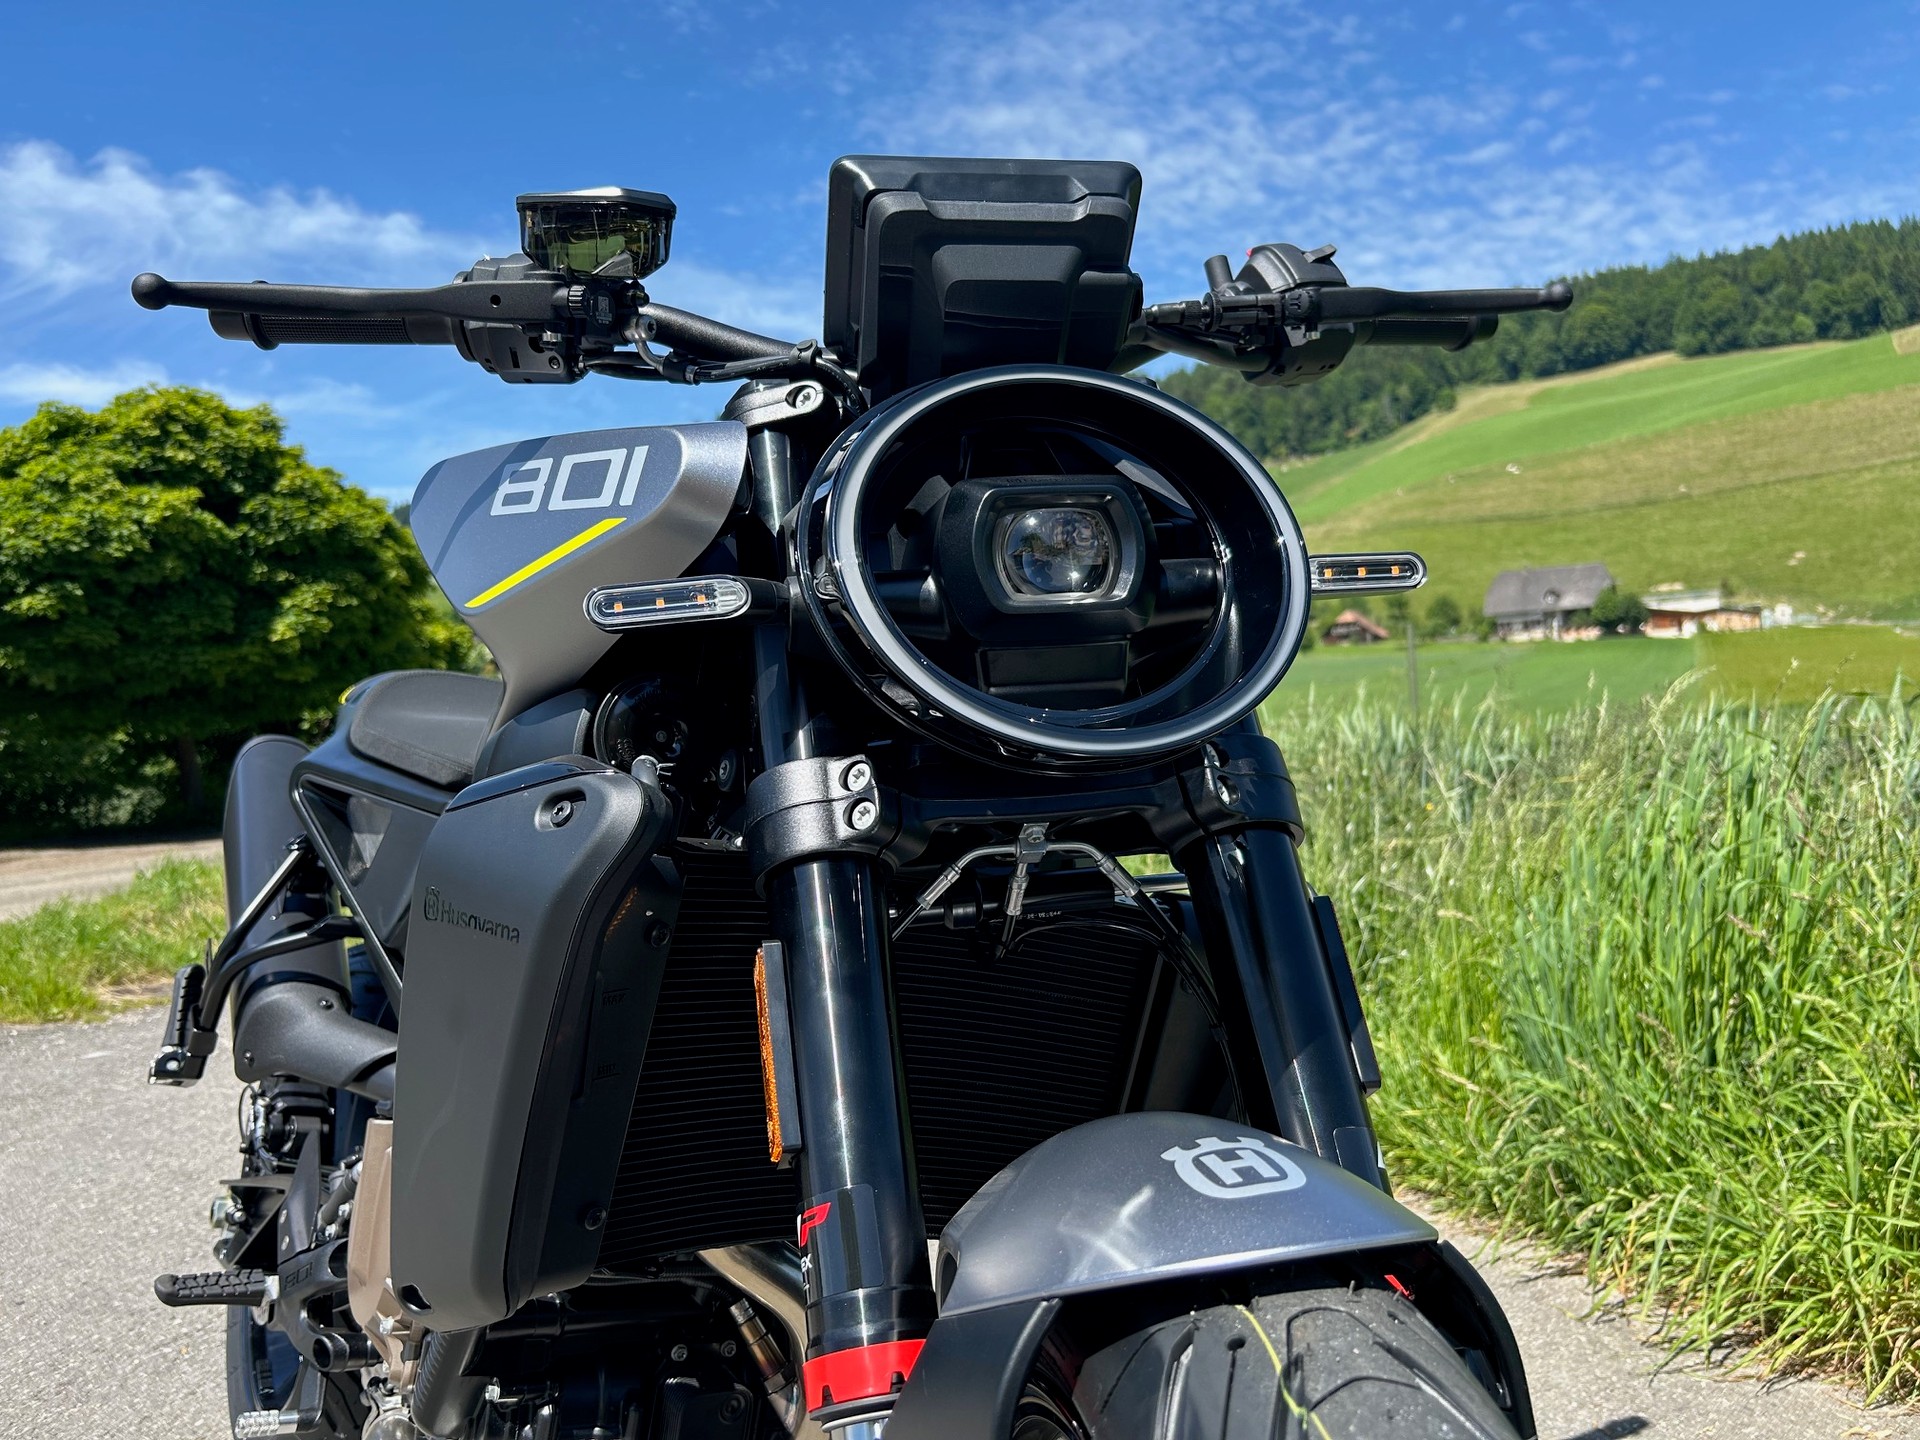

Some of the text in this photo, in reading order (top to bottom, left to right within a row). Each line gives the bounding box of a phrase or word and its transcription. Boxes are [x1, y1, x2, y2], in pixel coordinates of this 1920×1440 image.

[490, 445, 649, 516] 801
[441, 899, 520, 943] Husqvarna
[797, 1201, 832, 1249] P
